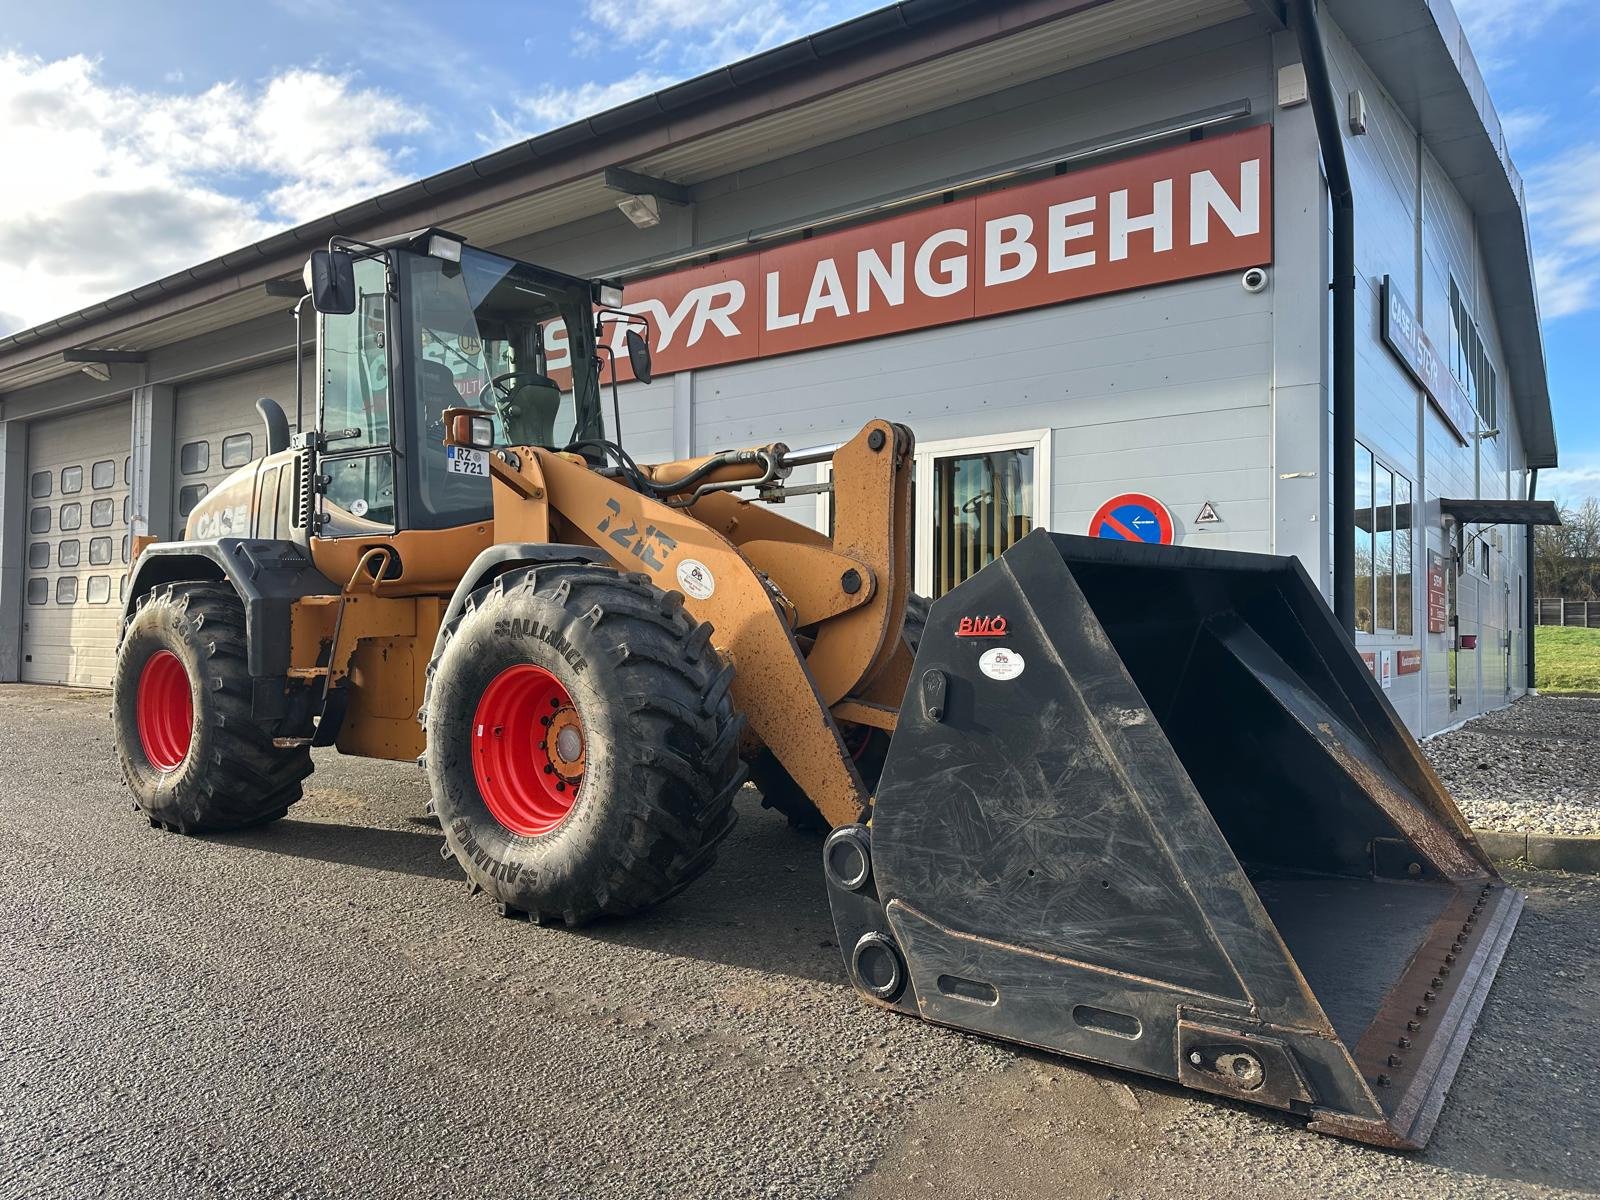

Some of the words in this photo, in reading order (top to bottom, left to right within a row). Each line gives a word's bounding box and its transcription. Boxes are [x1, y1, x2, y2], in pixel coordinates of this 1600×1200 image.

[766, 159, 1260, 330] LANGBEHN
[454, 460, 461, 472] E
[463, 462, 483, 475] 721
[457, 448, 471, 461] RZ
[197, 503, 248, 539] CASE
[510, 617, 588, 676] ALLIANCE
[451, 818, 524, 884] ALLIANCE
